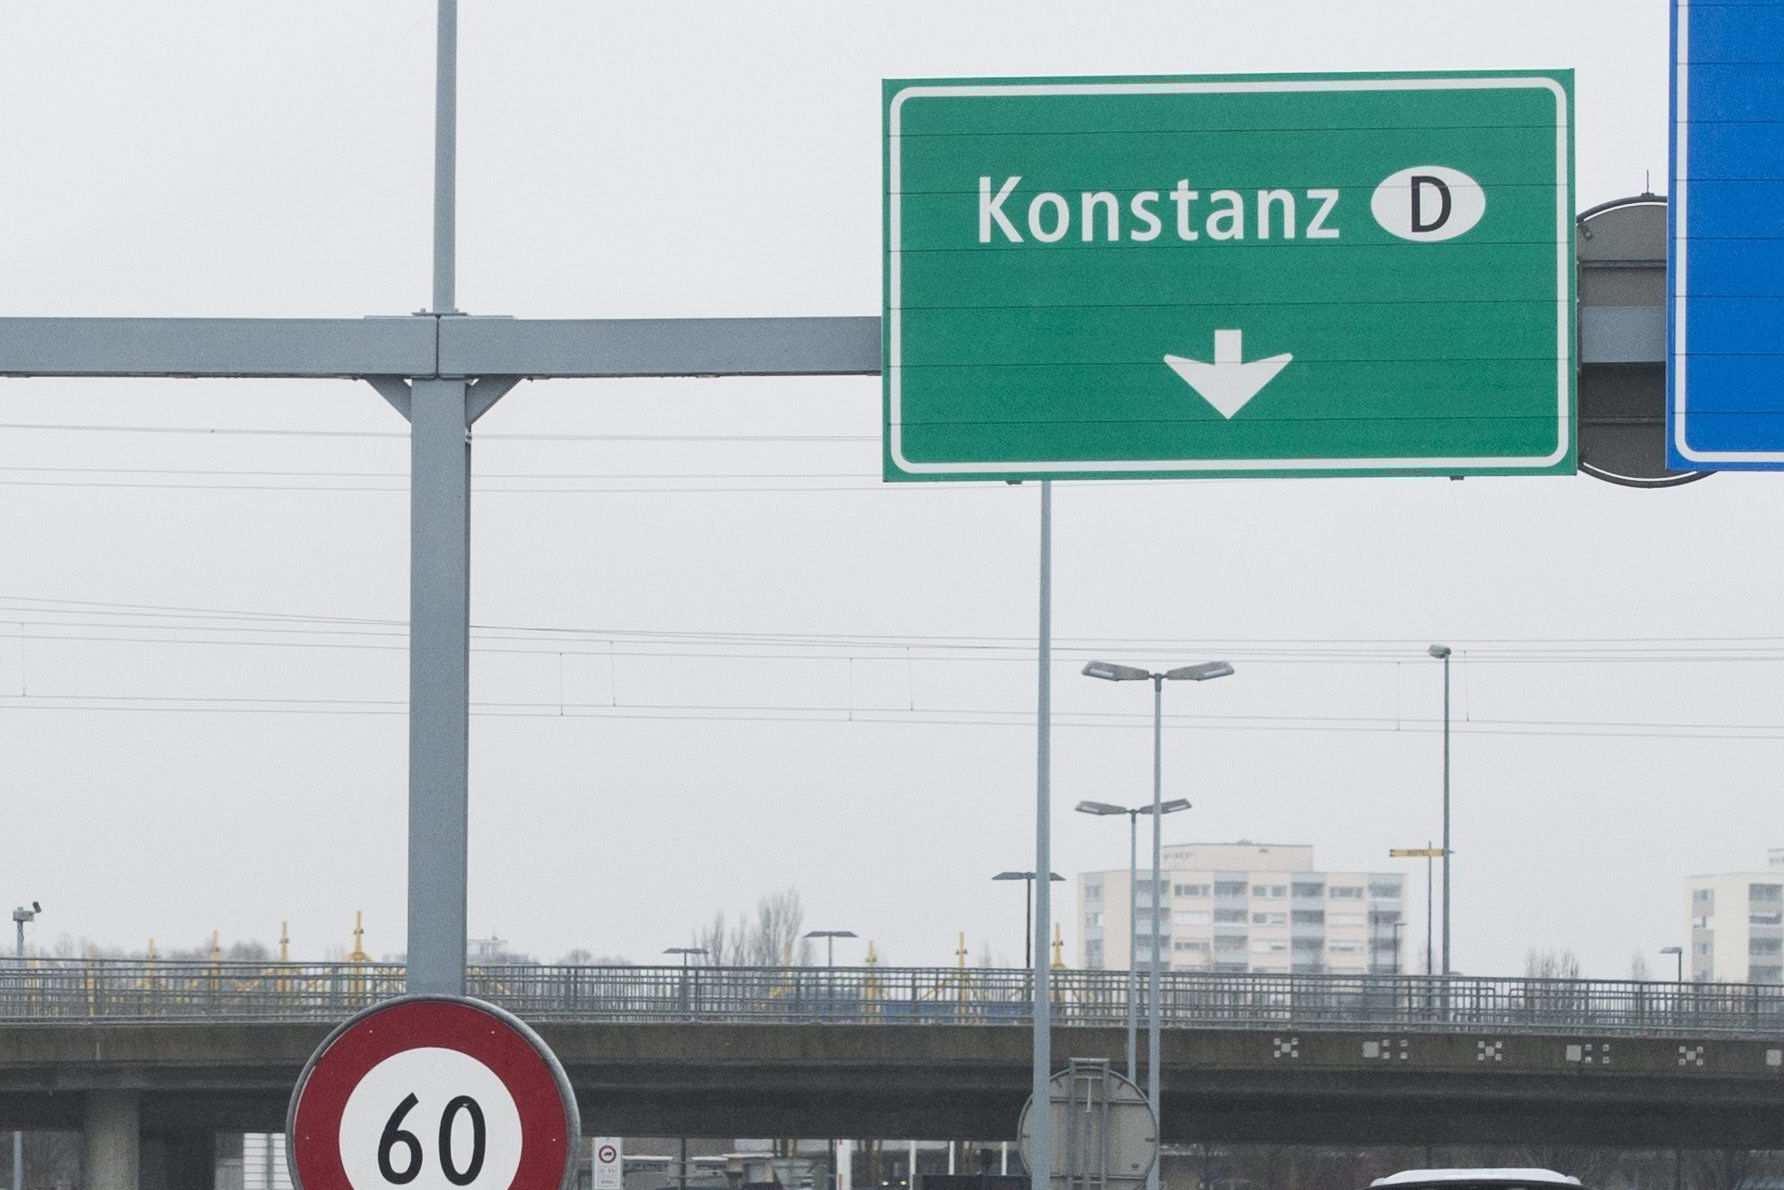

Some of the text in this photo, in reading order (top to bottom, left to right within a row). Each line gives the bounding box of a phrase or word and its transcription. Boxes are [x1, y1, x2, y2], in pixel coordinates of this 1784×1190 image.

[978, 175, 1453, 244] Konstanz D
[377, 1091, 487, 1187] 60
